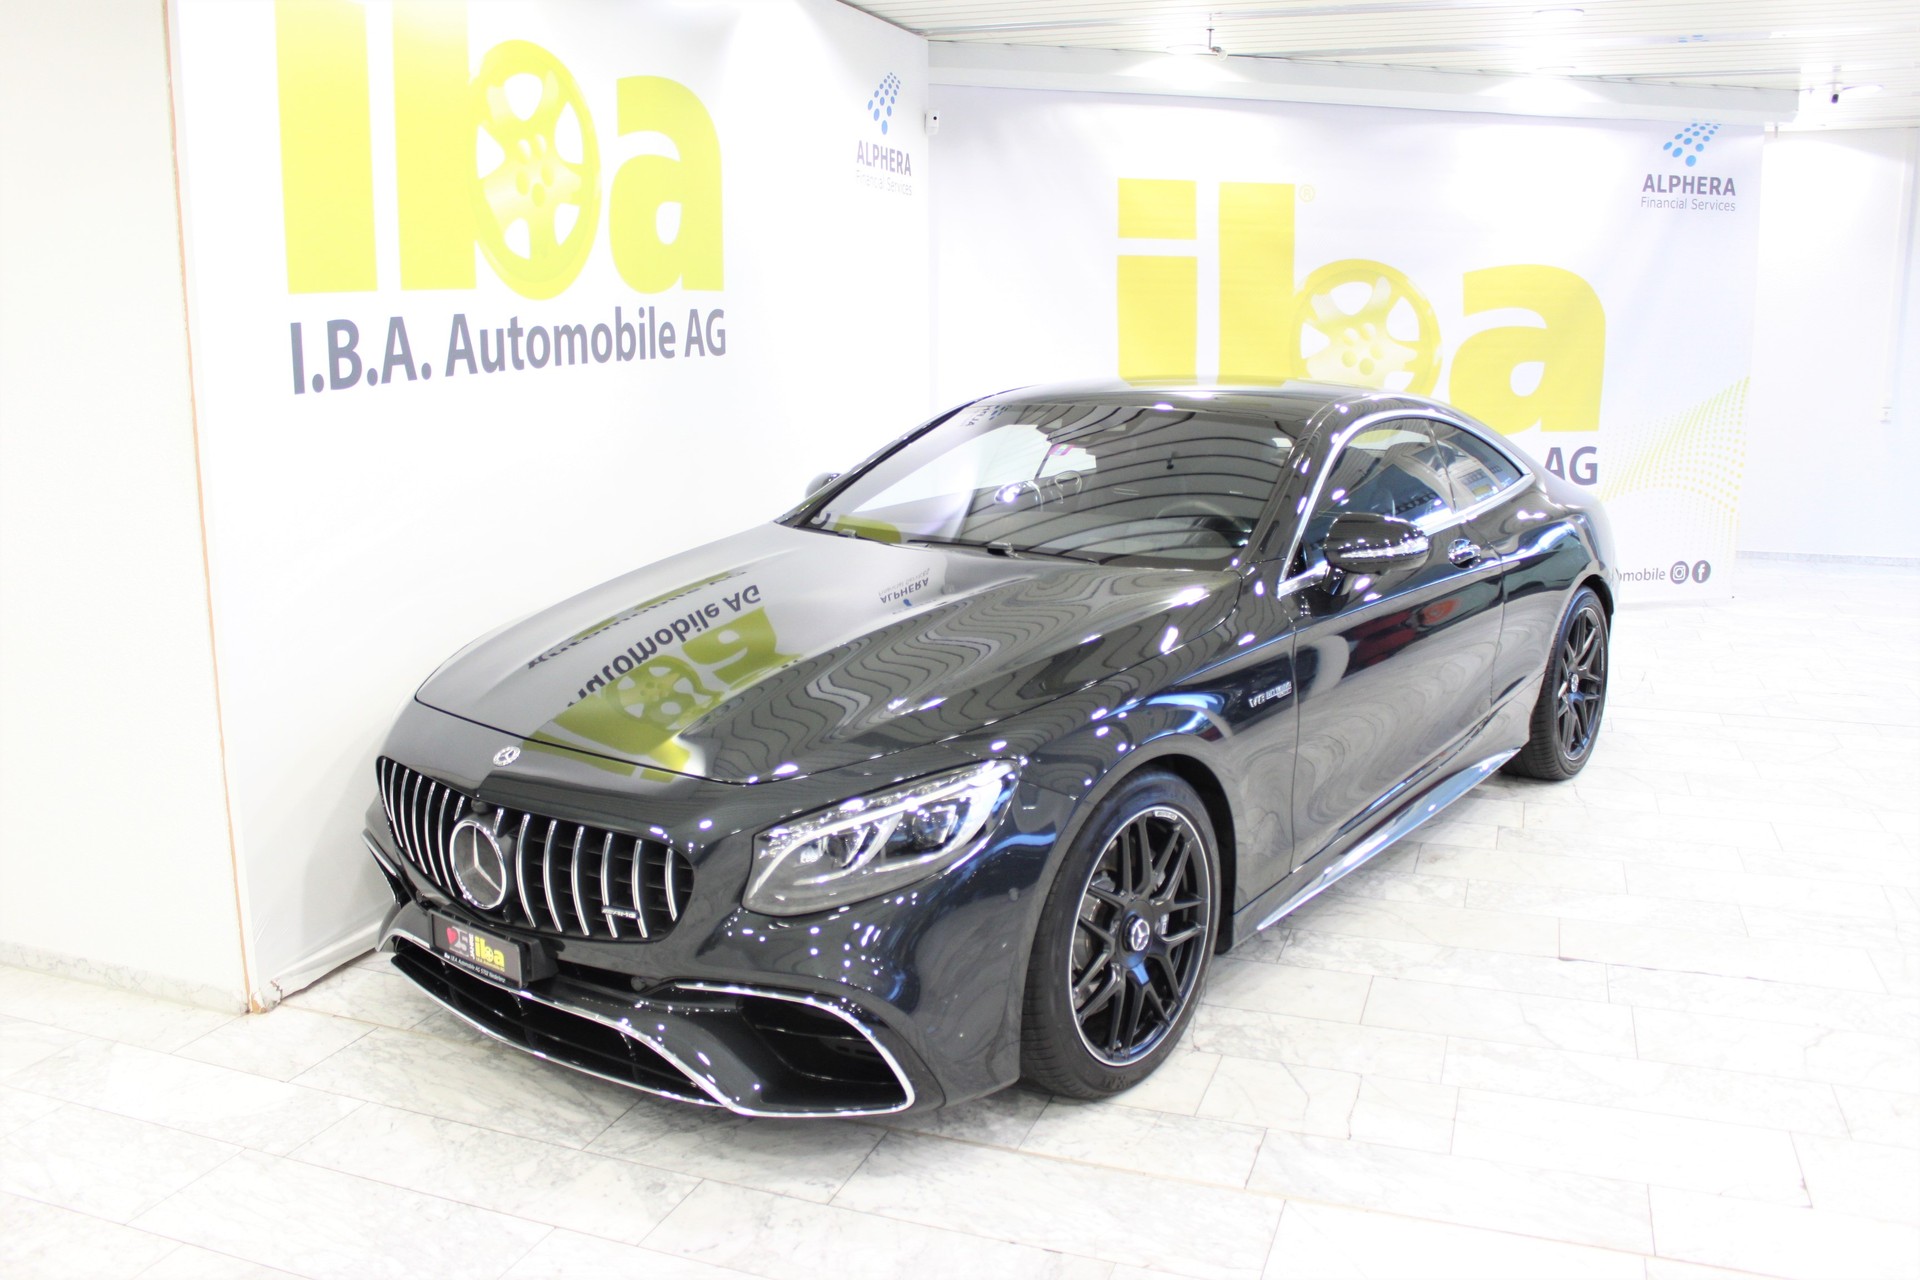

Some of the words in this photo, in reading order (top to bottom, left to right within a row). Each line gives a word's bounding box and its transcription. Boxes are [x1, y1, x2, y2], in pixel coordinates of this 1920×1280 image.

[856, 139, 912, 177] ALPHERA
[1642, 173, 1736, 196] ALPHERA
[1640, 196, 1687, 210] Financial
[1691, 198, 1736, 212] Services
[289, 316, 432, 395] I.B.A.
[445, 306, 676, 377] Automobile
[683, 308, 727, 357] AG
[1544, 446, 1598, 486] AG
[475, 935, 505, 968] iba
